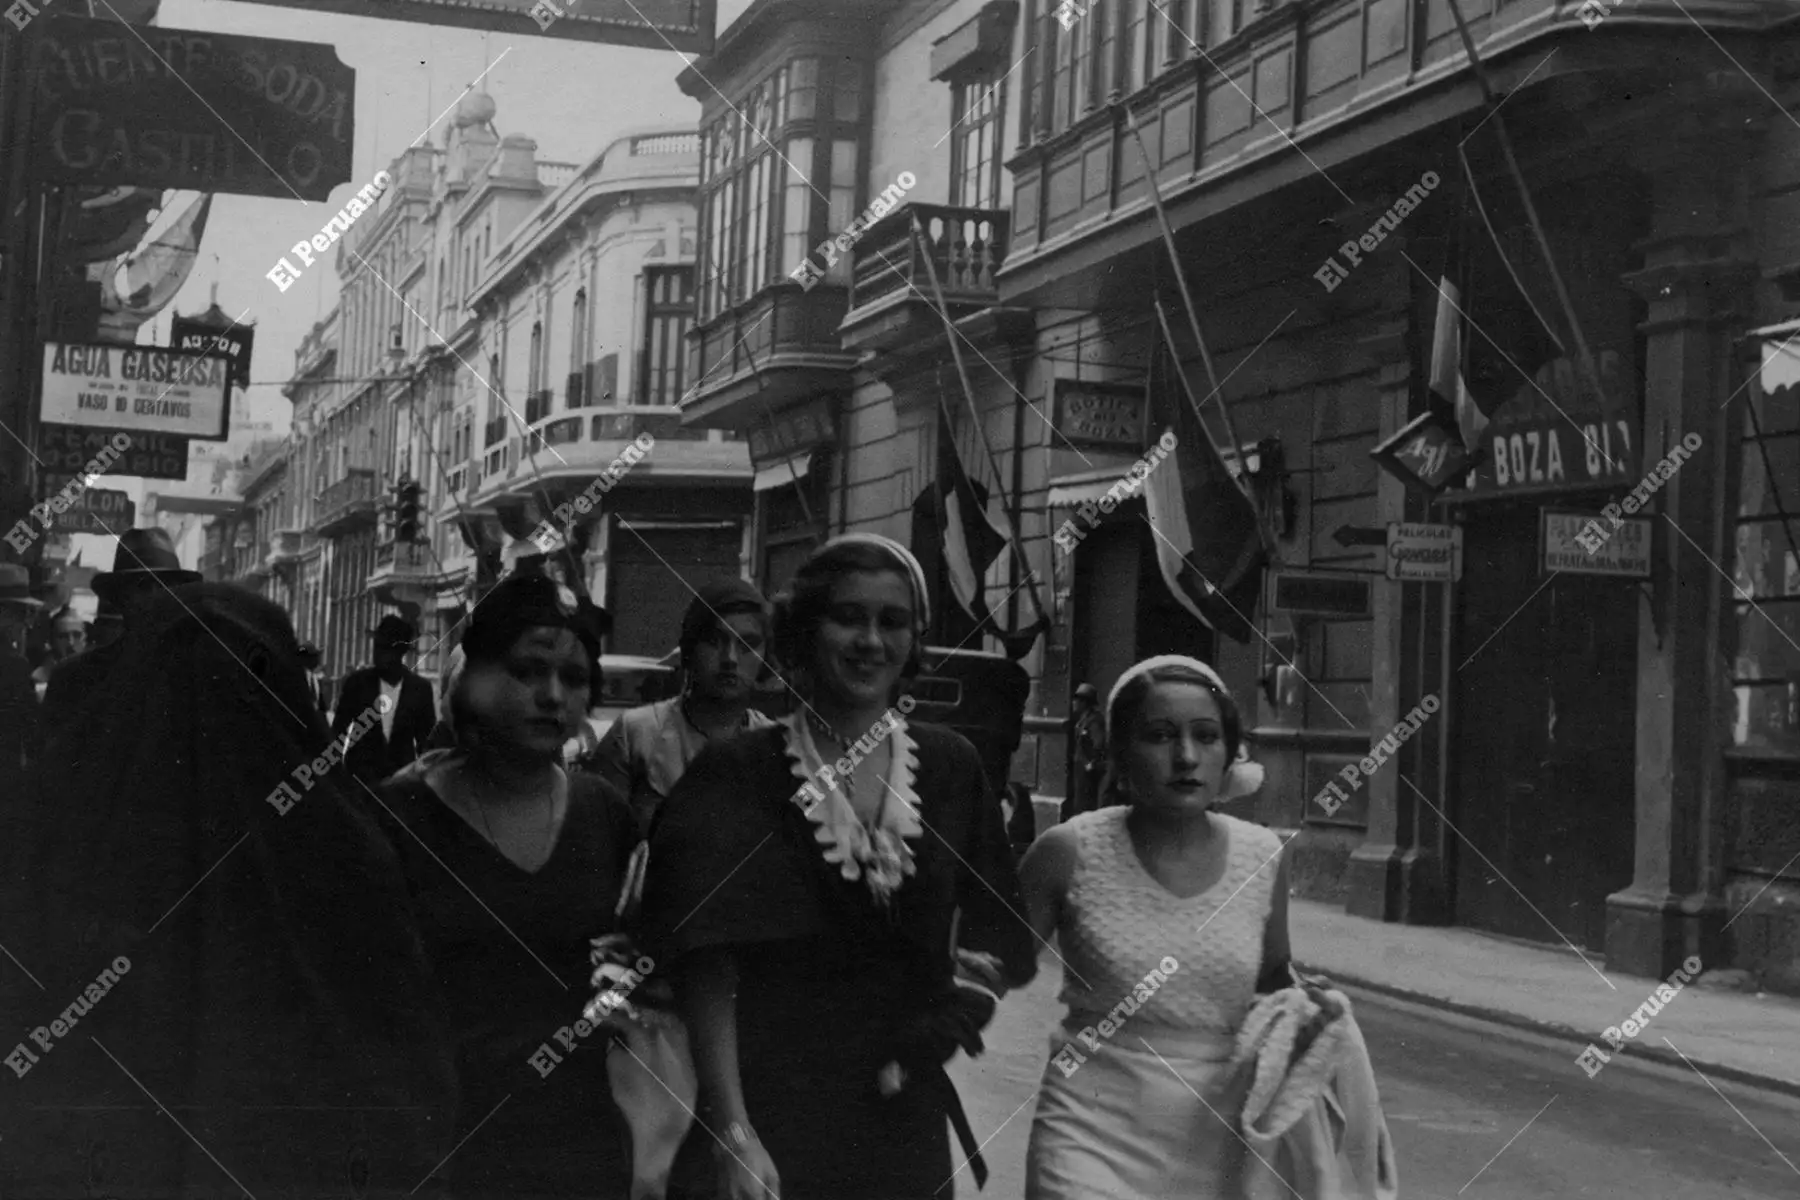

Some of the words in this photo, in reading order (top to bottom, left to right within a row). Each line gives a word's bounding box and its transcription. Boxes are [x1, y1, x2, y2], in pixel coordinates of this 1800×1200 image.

[51, 345, 110, 379] AGUA
[121, 350, 216, 388] GASEOSA
[78, 393, 108, 411] VASO
[134, 398, 191, 418] CENTAVOS
[1493, 429, 1564, 486] BOZA
